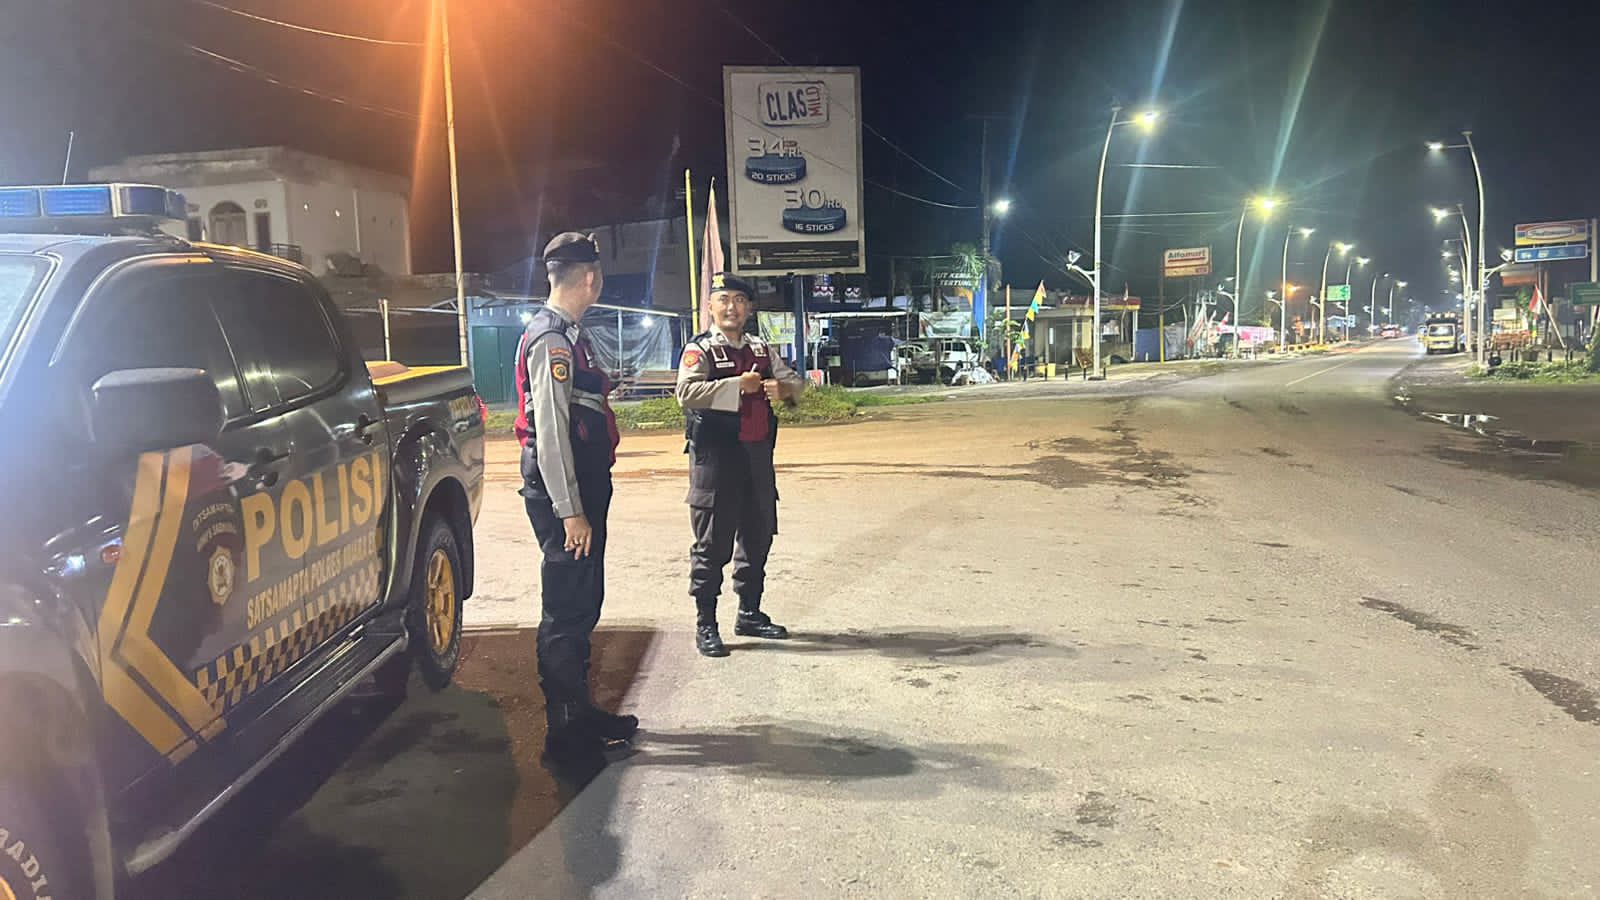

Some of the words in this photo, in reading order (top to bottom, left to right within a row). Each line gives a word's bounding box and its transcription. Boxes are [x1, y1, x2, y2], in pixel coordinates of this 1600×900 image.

[766, 89, 807, 121] CLAS
[805, 86, 823, 117] MILD
[751, 172, 764, 180] 20
[766, 173, 797, 182] STICKS
[806, 223, 835, 232] STICKS
[1168, 250, 1206, 258] Alfamart
[241, 452, 383, 583] POLISI
[0, 828, 52, 900] RADI
